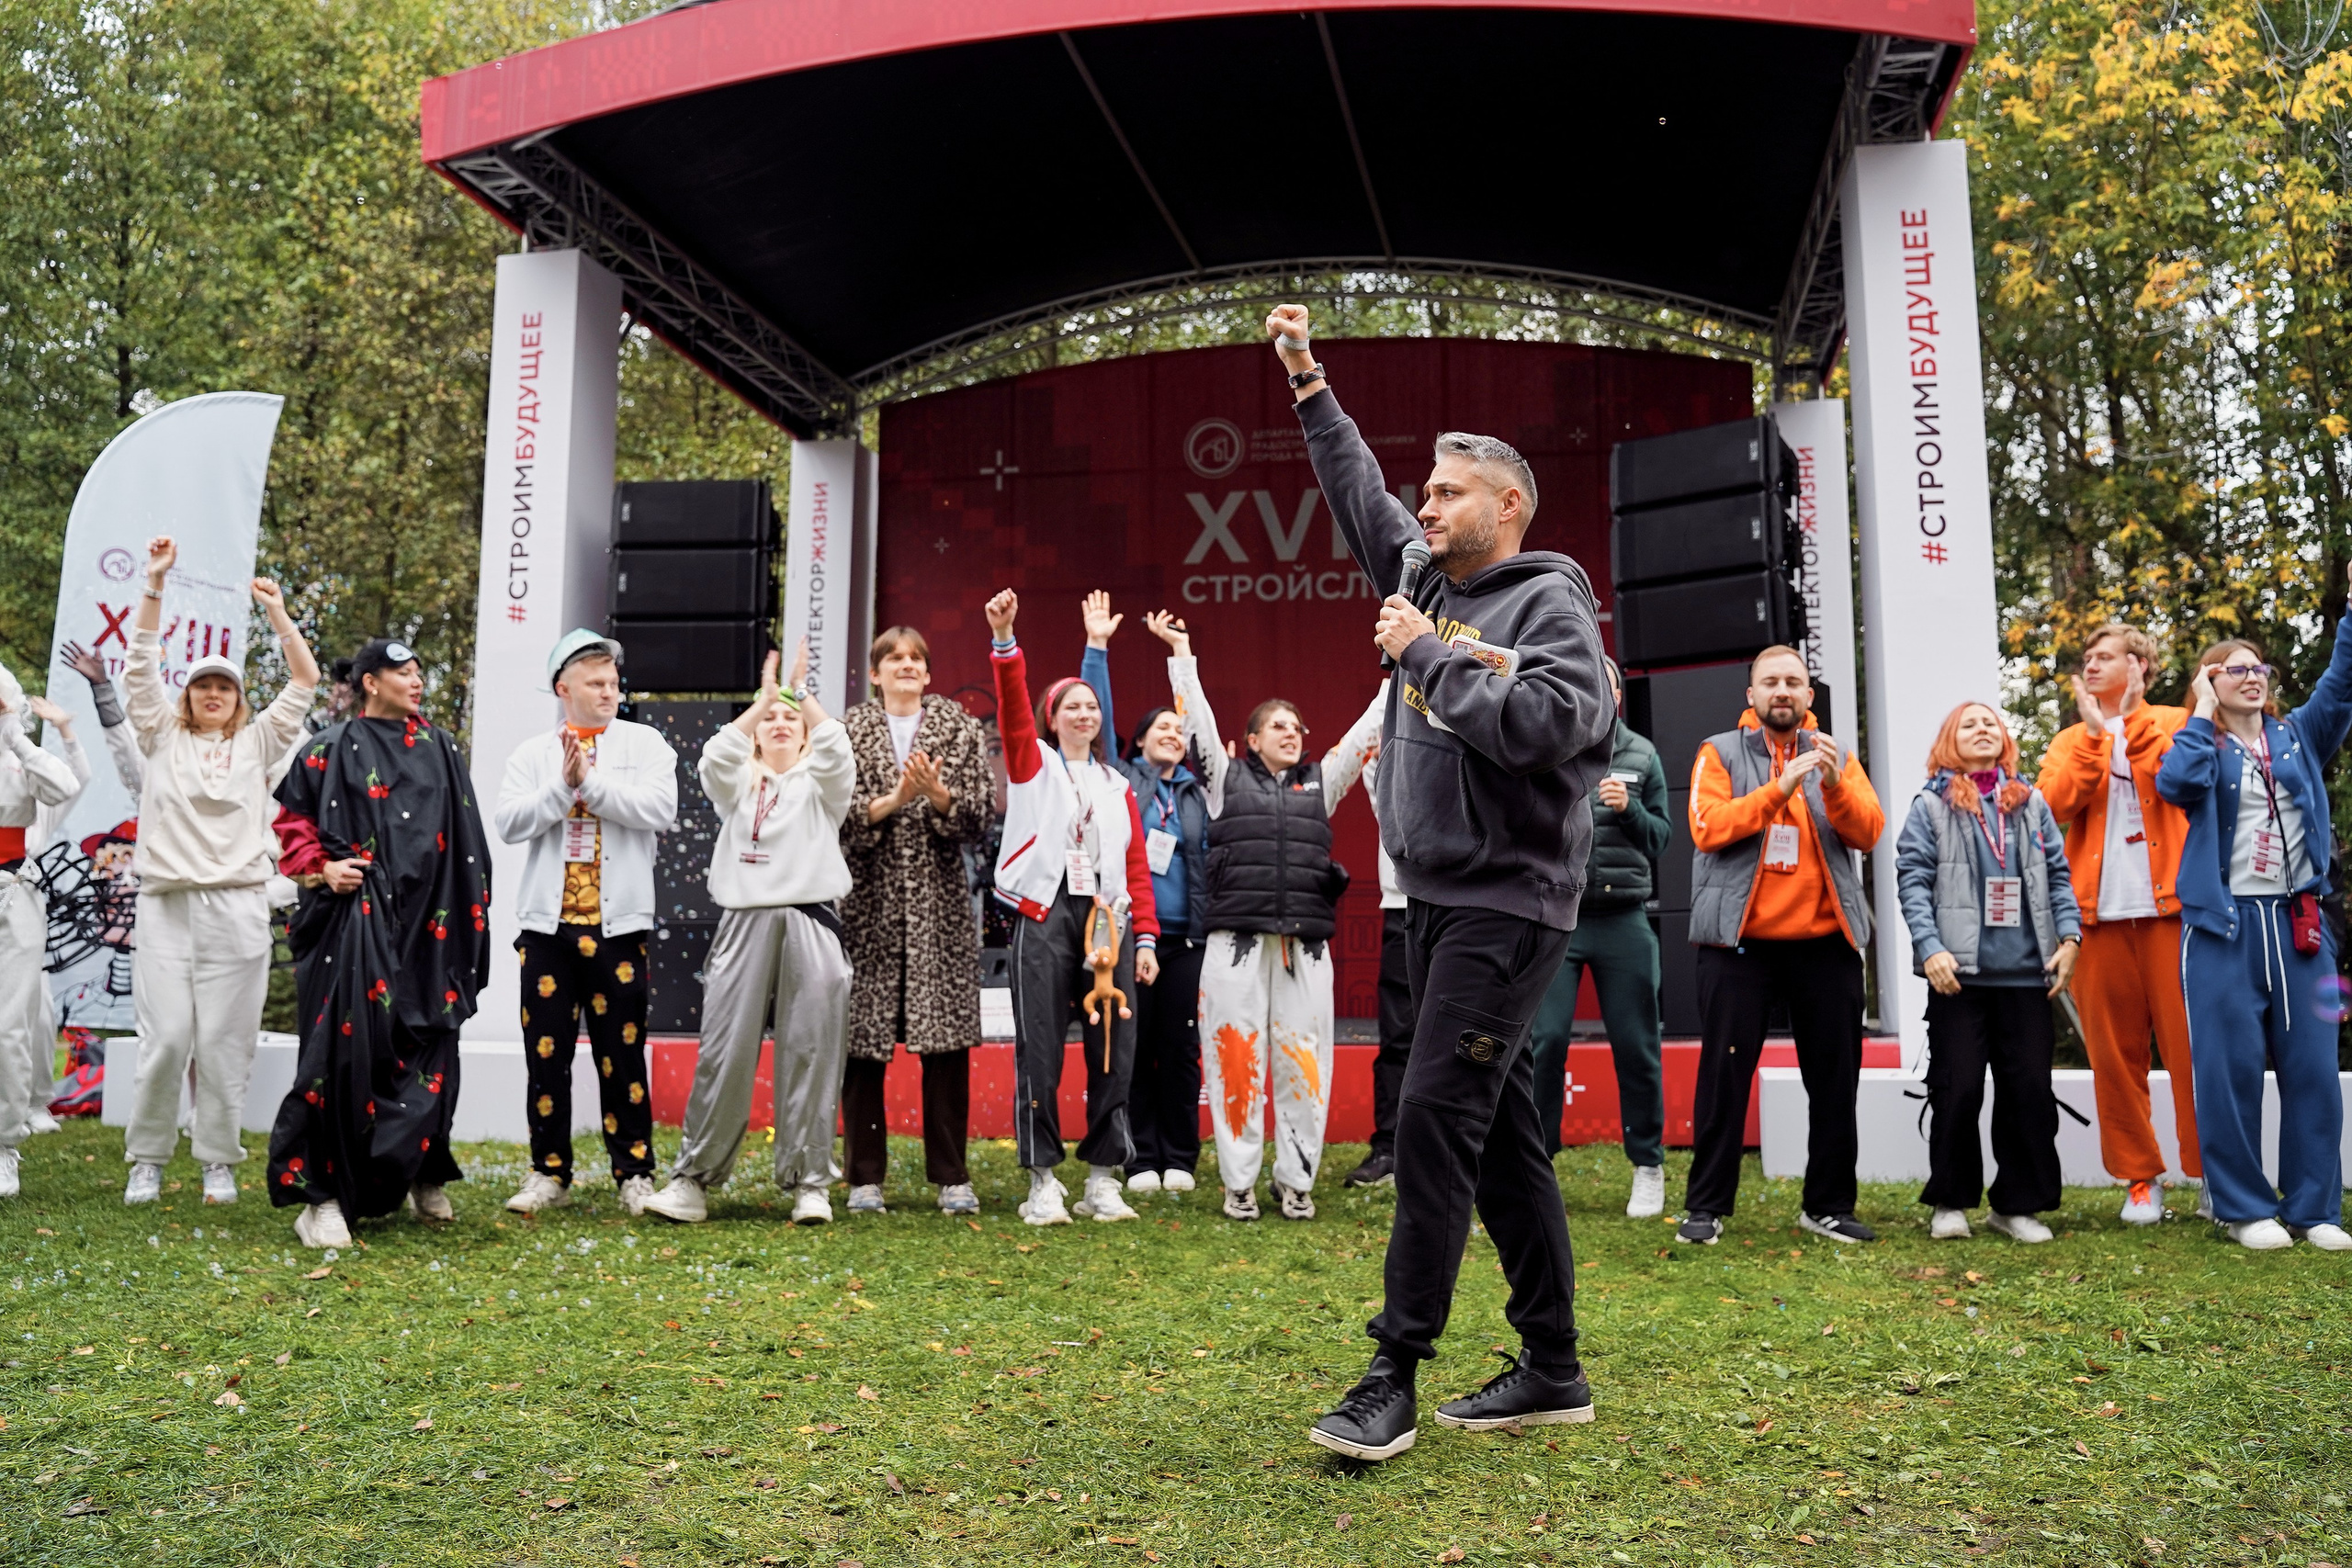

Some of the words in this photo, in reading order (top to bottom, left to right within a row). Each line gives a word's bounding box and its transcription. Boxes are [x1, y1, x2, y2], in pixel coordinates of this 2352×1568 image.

[507, 310, 545, 625] #СТРОИМБУДУЩЕЕ
[1901, 208, 1949, 566] #СТРОИМБУДУЩЕЕ
[1182, 563, 1376, 604] СТРОЙСЛ
